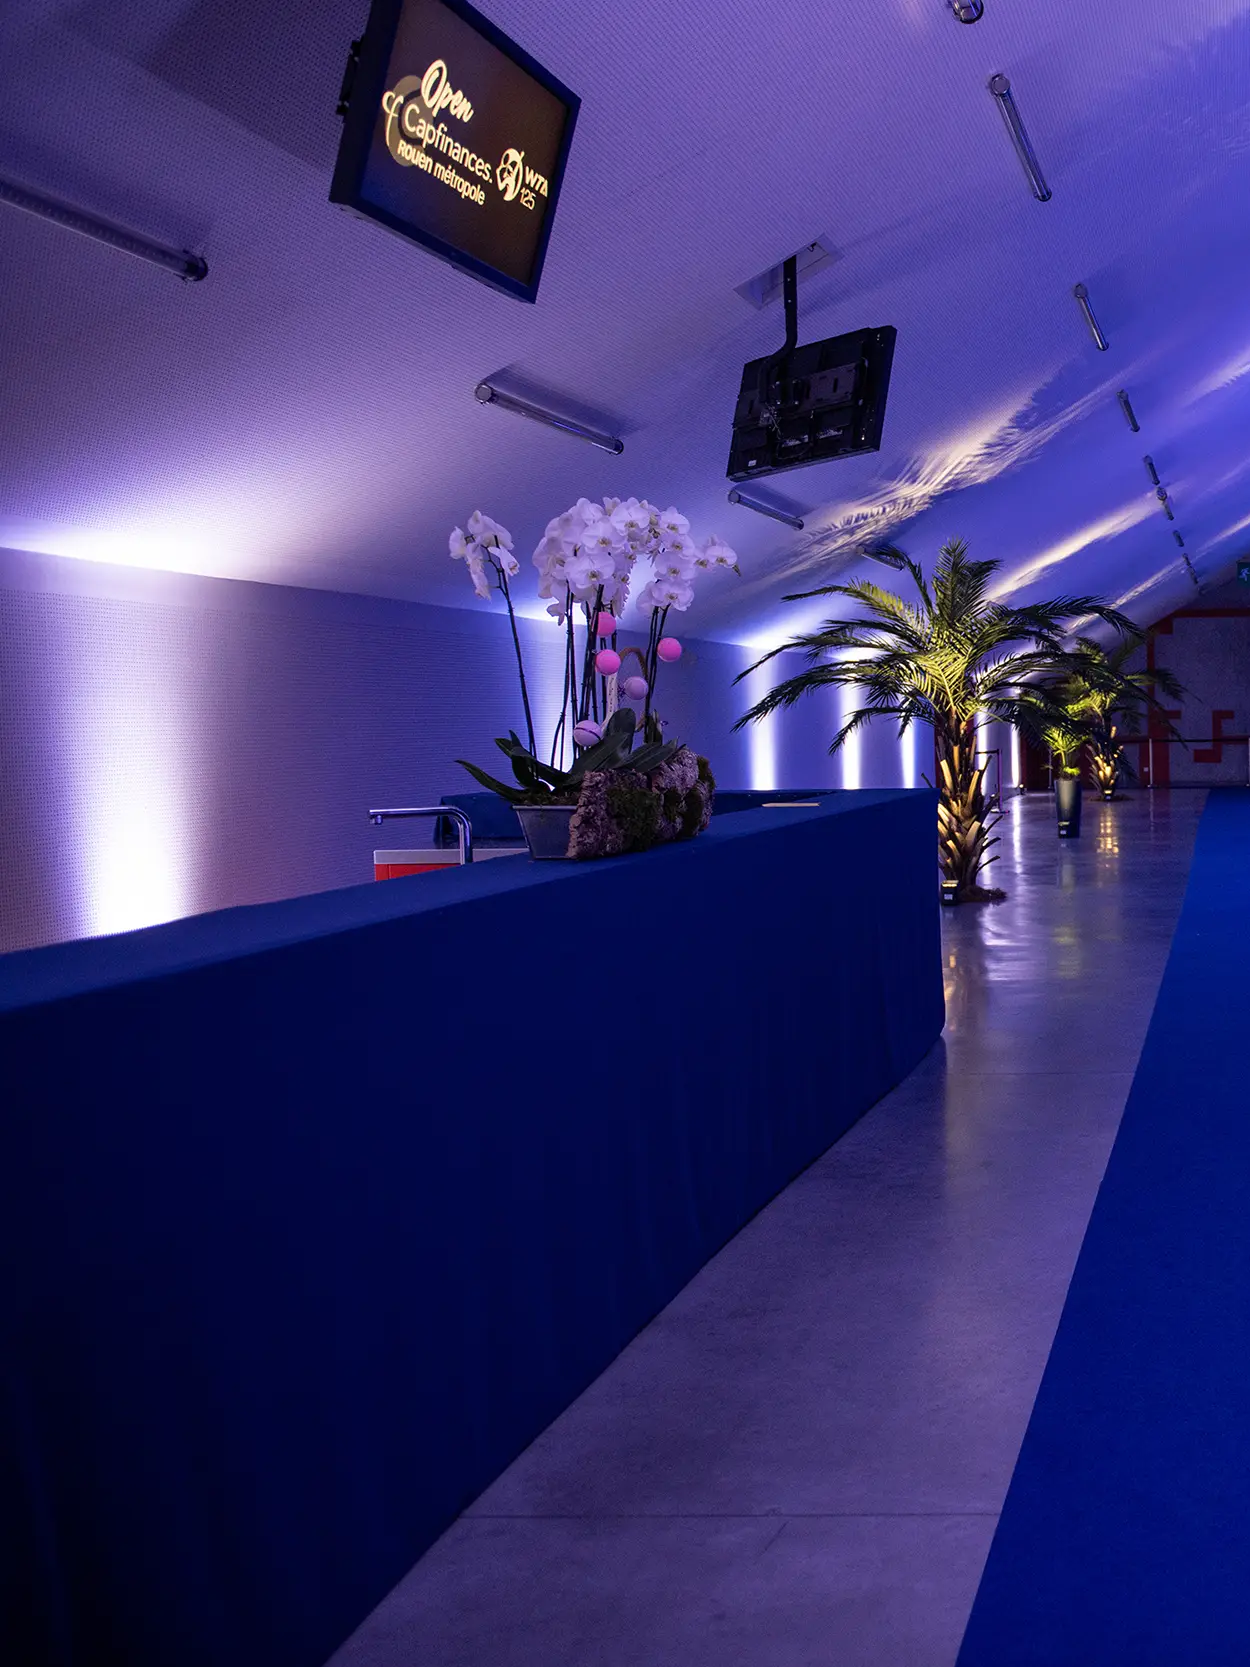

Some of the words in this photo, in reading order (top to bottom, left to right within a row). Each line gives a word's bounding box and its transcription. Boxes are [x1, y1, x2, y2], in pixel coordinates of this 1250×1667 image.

[421, 59, 475, 123] Open
[433, 164, 486, 206] métropole
[520, 187, 536, 210] 125
